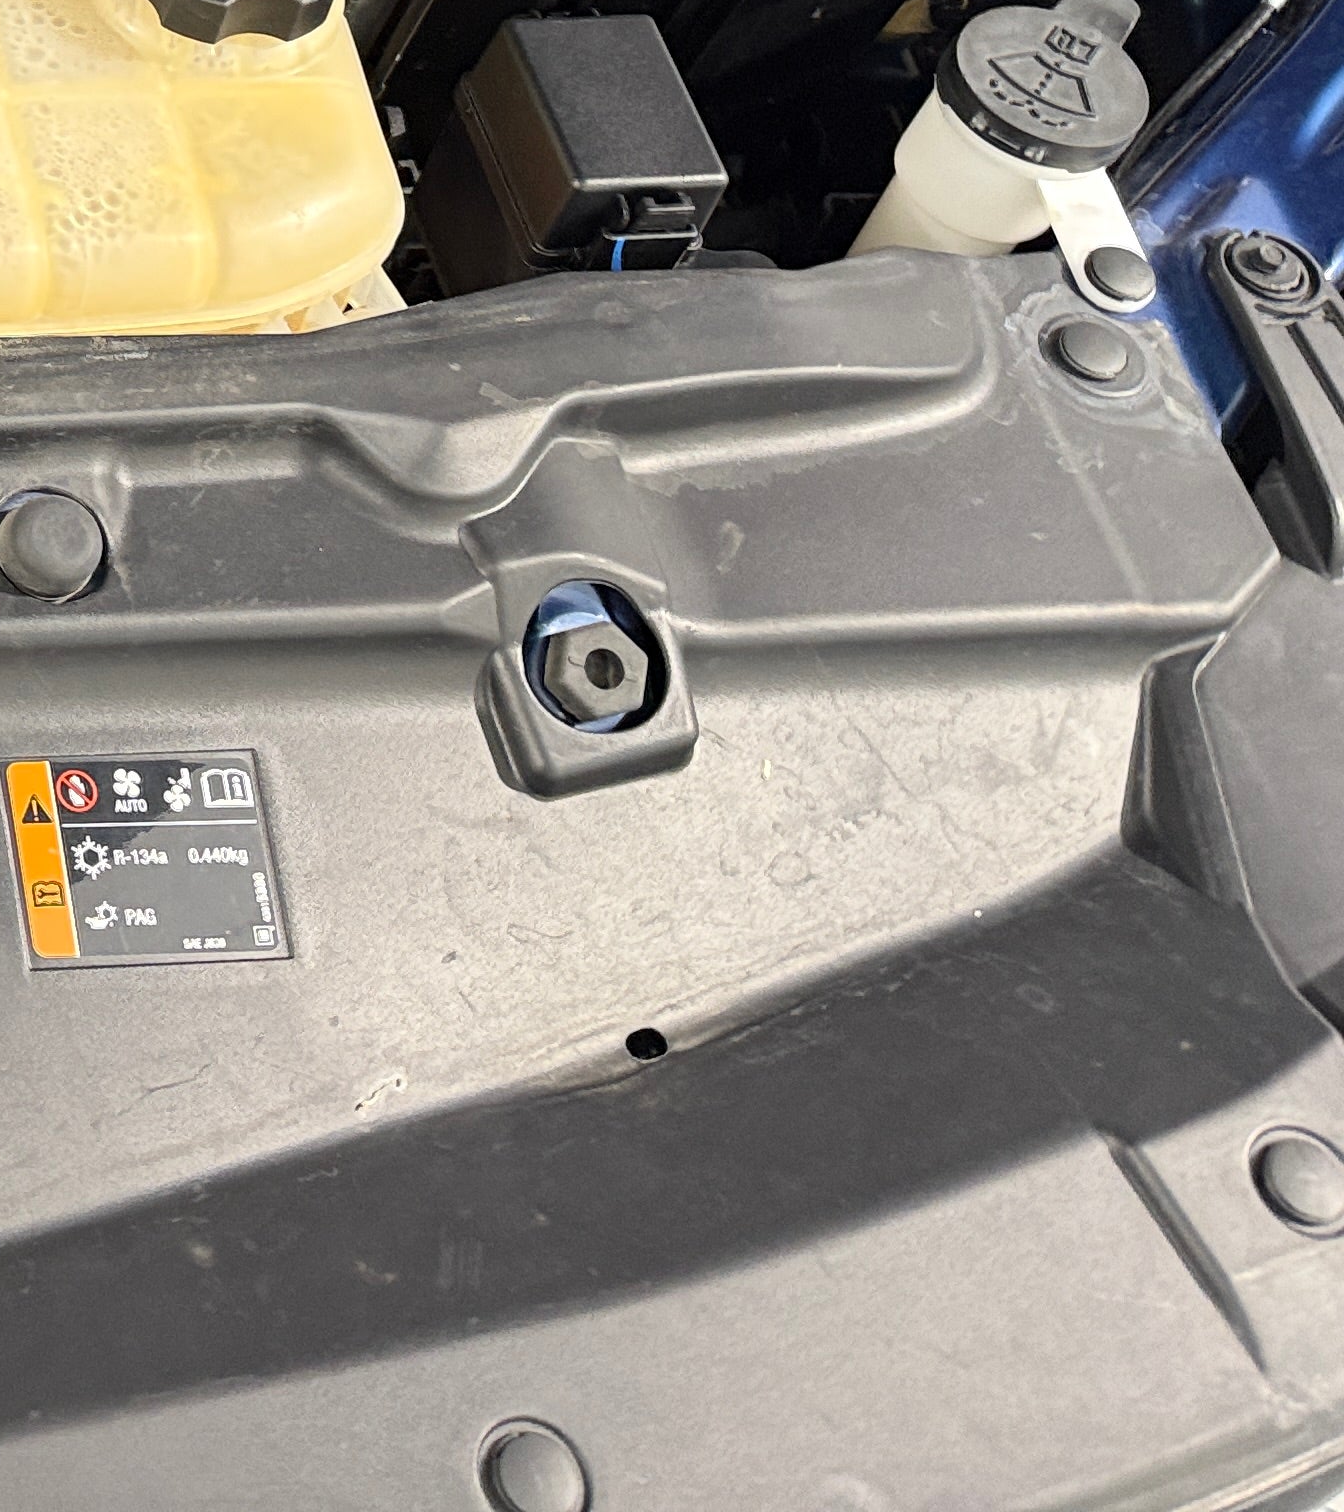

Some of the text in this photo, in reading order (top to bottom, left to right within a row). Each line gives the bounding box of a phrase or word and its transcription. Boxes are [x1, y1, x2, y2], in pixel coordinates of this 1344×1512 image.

[114, 799, 148, 813] AUTO
[113, 846, 249, 866] R-134a 0.440kg
[125, 908, 158, 926] PAG
